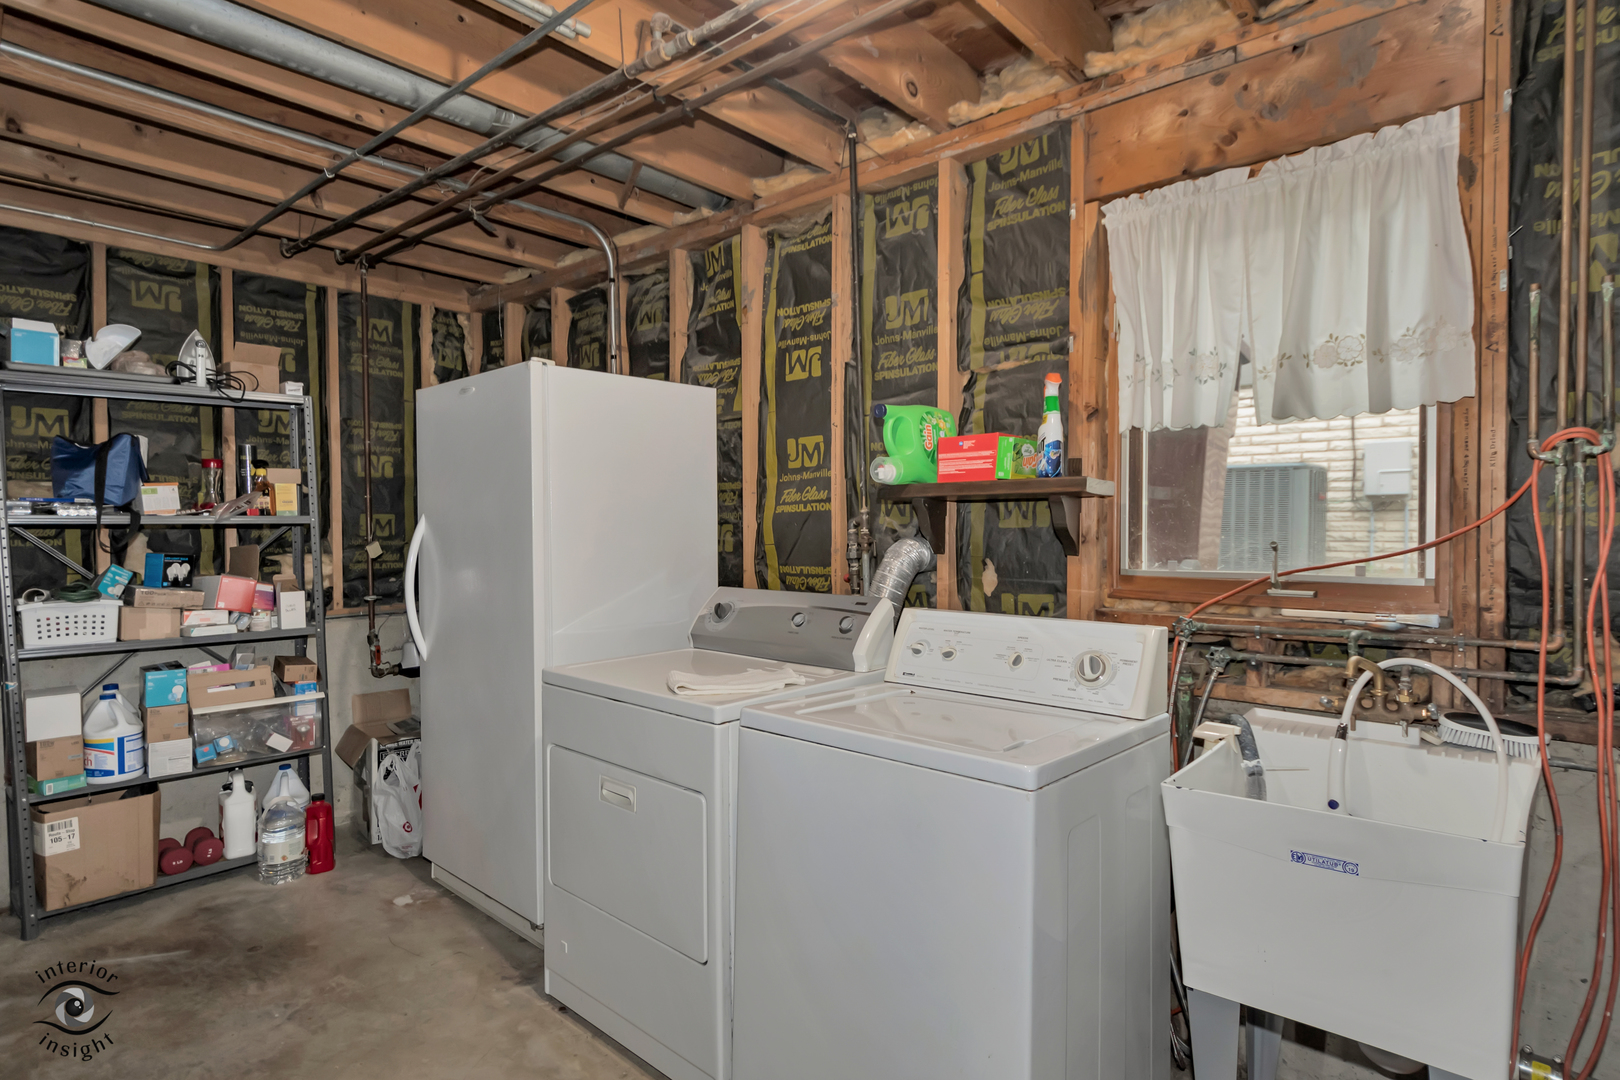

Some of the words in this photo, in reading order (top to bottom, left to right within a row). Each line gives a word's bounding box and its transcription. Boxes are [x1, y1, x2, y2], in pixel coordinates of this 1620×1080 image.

[988, 158, 1064, 193] Johns-Manville
[991, 193, 1026, 219] Fiber
[1025, 184, 1060, 209] Glass
[885, 195, 931, 239] JM
[987, 200, 1067, 231] SPINSULATION
[131, 280, 182, 313] JM
[987, 287, 1067, 308] SPINSULATION
[238, 304, 305, 320] SPINSULATION
[776, 298, 832, 317] SPINSULATION
[804, 308, 827, 327] Fiber
[885, 288, 929, 330] JM
[989, 304, 1025, 325] Glass
[1024, 299, 1060, 320] Fiber
[244, 313, 274, 329] Glass
[275, 319, 302, 332] Fiber
[240, 331, 306, 346] Johns-Manville
[874, 324, 938, 346] Johns-Manville
[984, 326, 1064, 347] Johns-Manville
[785, 345, 822, 382] JM
[877, 350, 906, 370] Fiber
[906, 346, 936, 366] Glass
[874, 361, 938, 382] SPINSULATION
[11, 406, 69, 437] JM
[121, 411, 198, 424] SPINSULATION
[924, 423, 934, 451] Gain
[786, 434, 825, 469] JM
[779, 468, 832, 483] Johns-Manville
[780, 488, 802, 504] Fiber
[802, 486, 828, 501] Glass
[775, 502, 832, 514] SPINSULATION
[50, 836, 63, 845] 105
